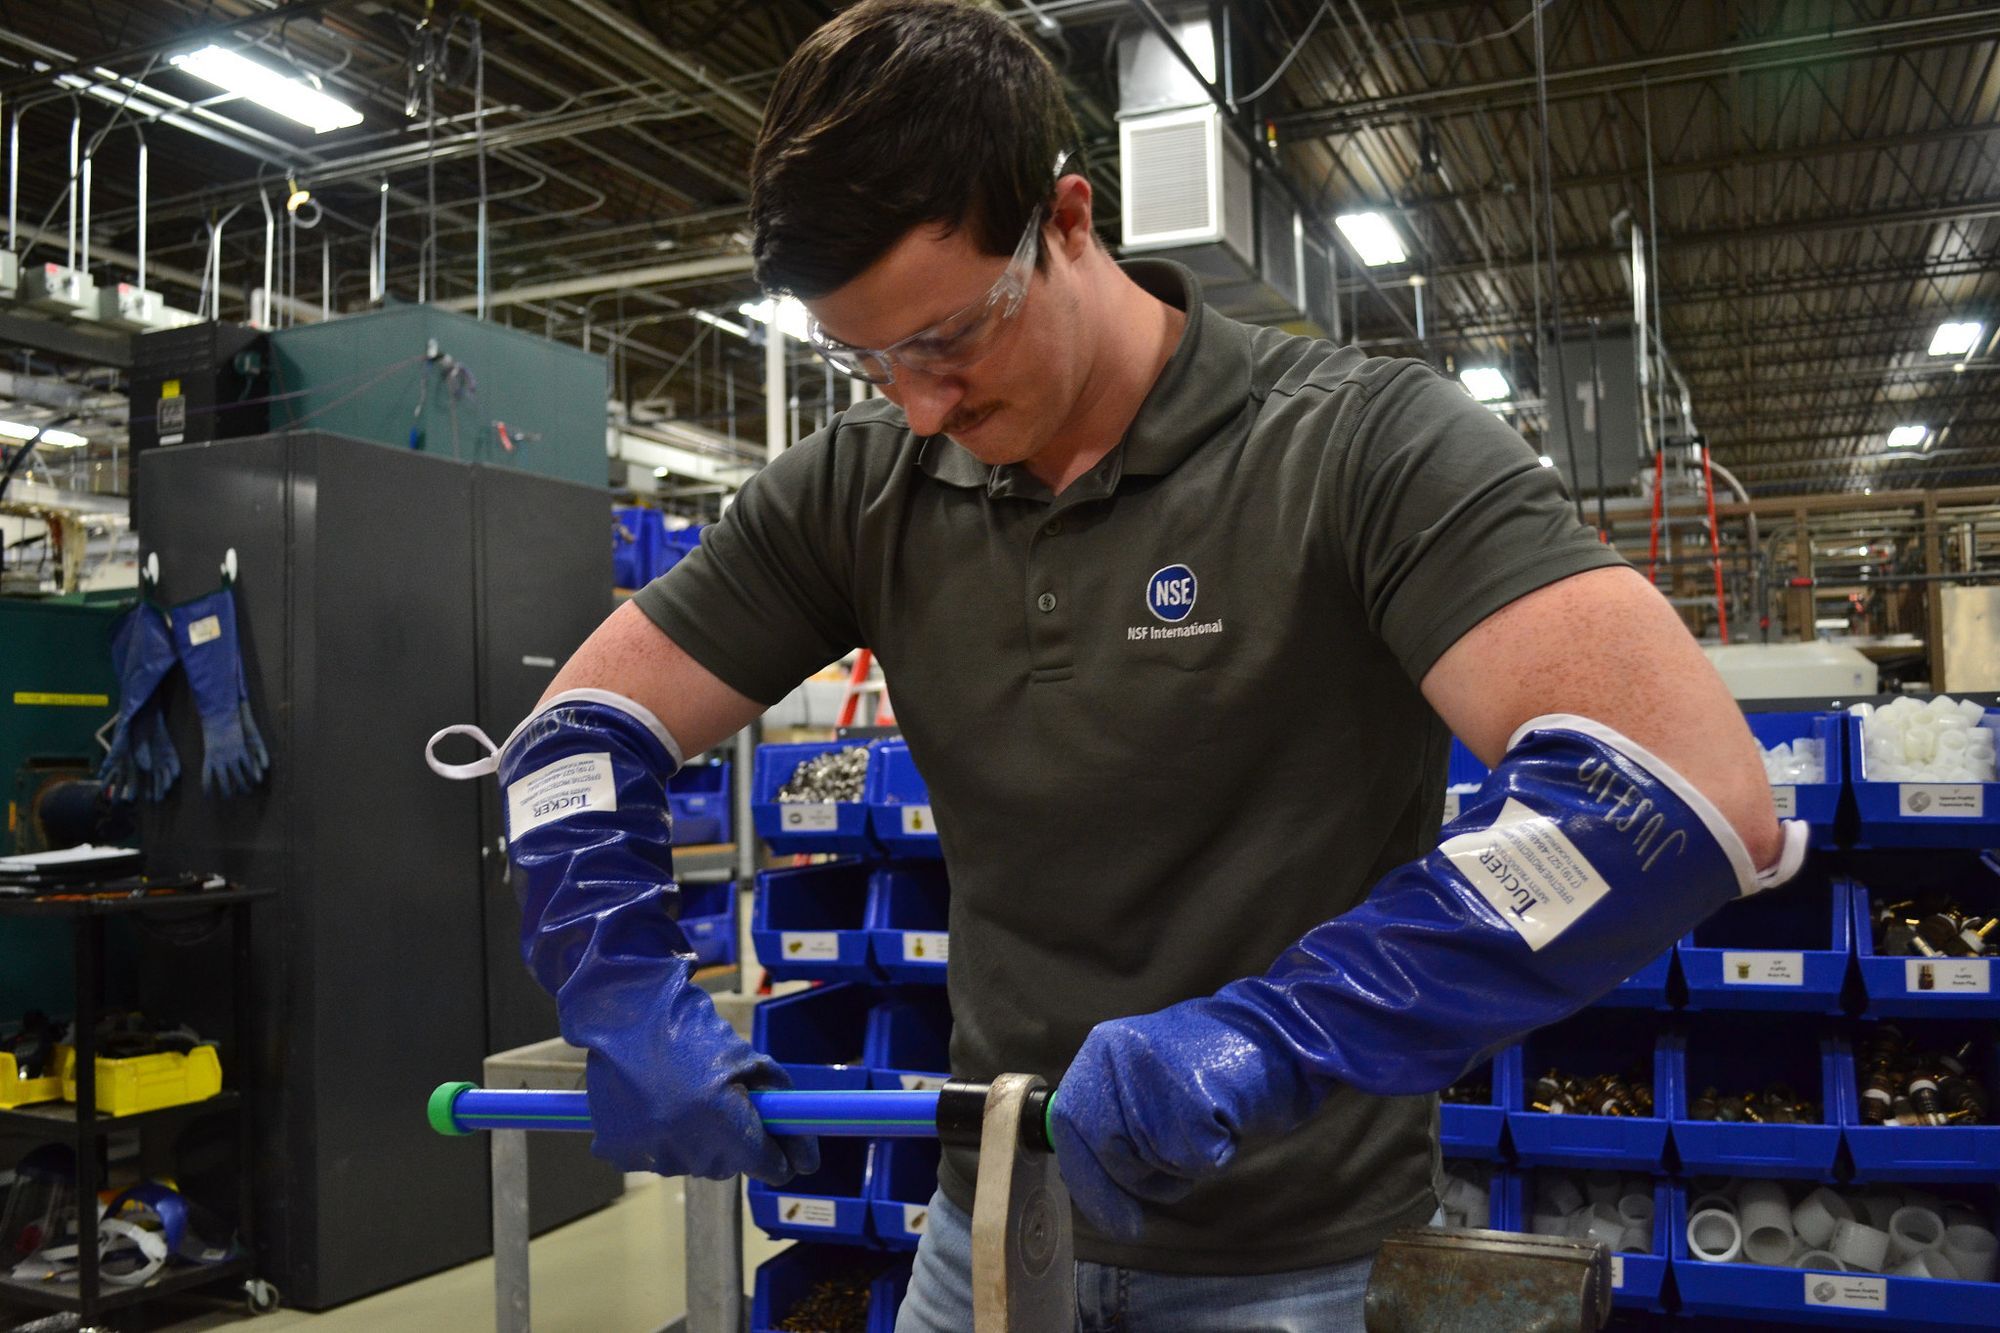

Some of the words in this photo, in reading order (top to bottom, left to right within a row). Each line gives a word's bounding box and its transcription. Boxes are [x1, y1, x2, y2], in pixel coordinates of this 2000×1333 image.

[1127, 626, 1149, 640] NSF
[1150, 618, 1223, 640] International
[1499, 849, 1530, 883] PRODUCTS
[1510, 836, 1547, 874] PROTECTIVE
[1479, 851, 1537, 921] TUCKER
[1527, 881, 1550, 905] SAFETY
[1542, 870, 1575, 905] EFFECTIVE
[1558, 866, 1581, 890] (719)
